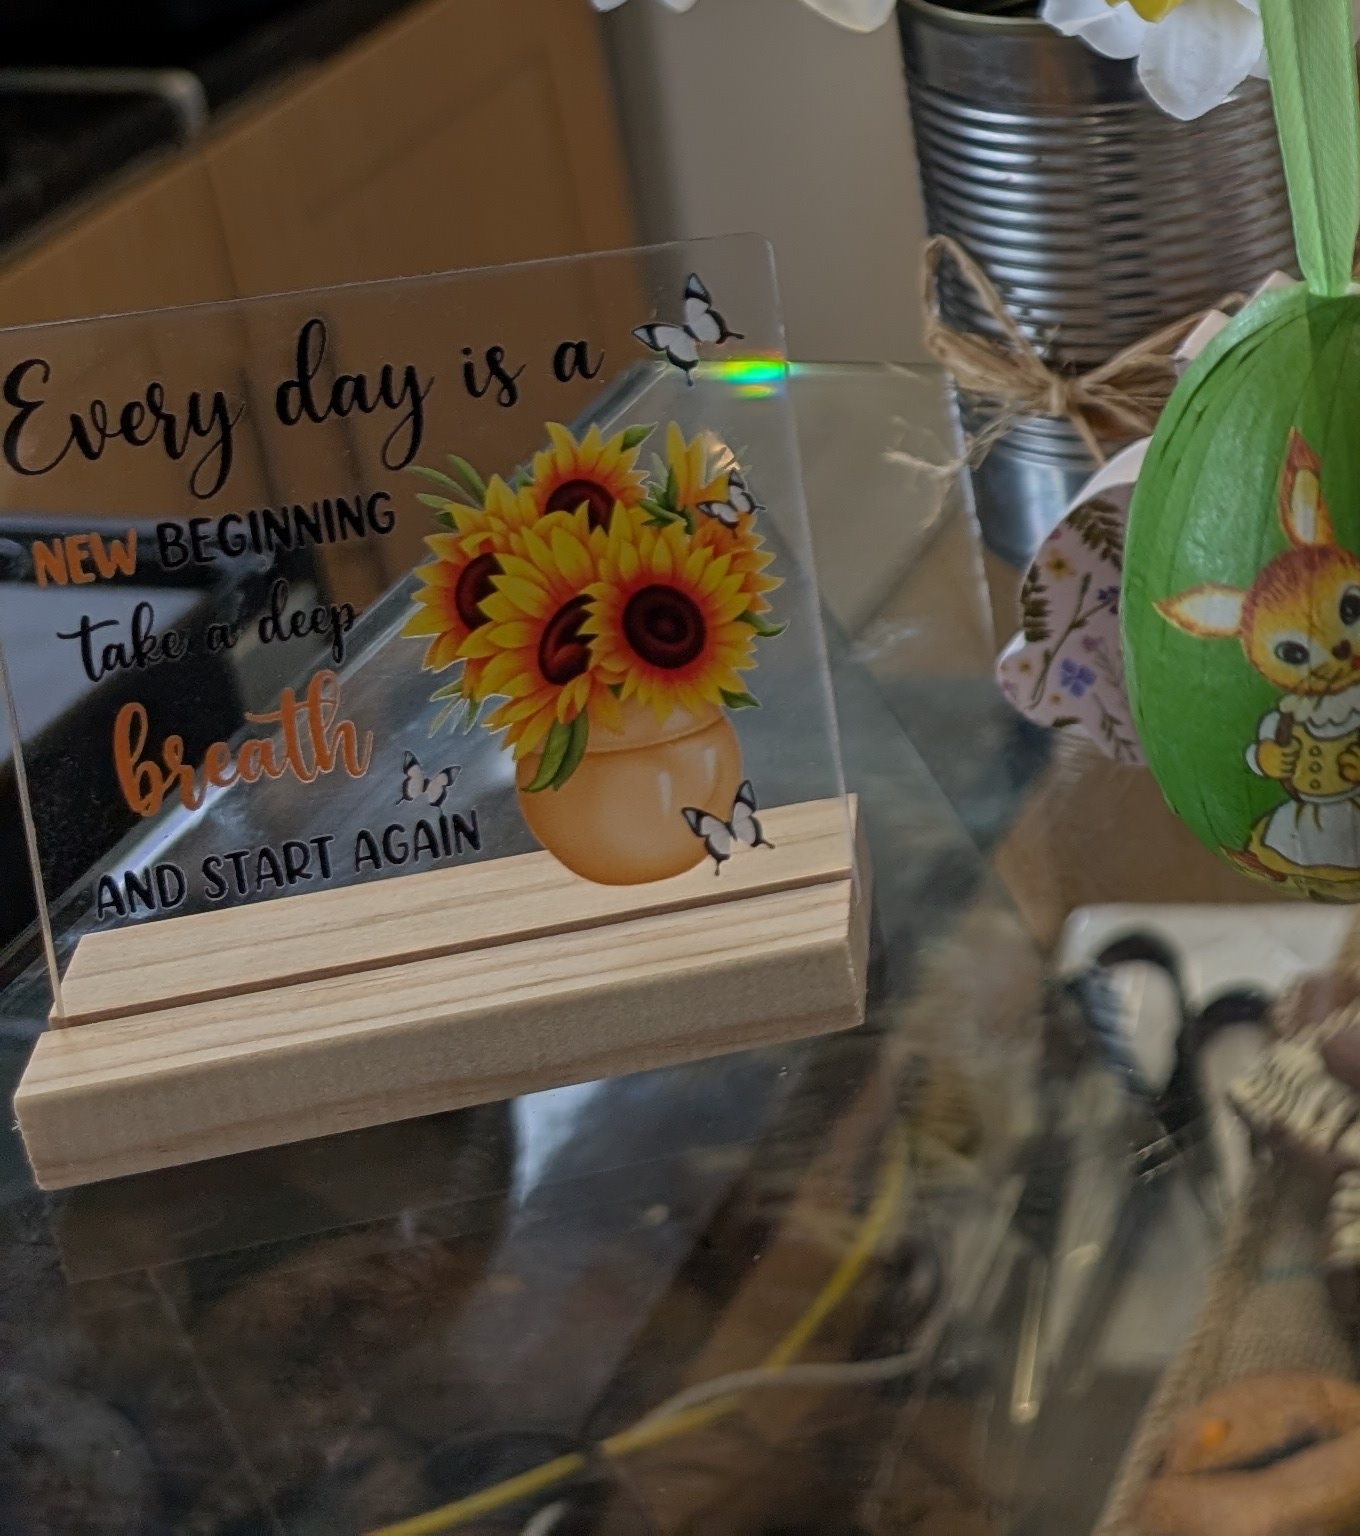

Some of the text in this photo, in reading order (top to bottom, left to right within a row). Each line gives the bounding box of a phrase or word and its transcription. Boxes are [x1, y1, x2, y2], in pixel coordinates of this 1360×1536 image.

[2, 318, 606, 500] Every day is a
[31, 491, 397, 588] NEW BEGINNING
[56, 577, 360, 683] take a deep
[112, 669, 374, 818] breath
[97, 809, 482, 920] AND START AGAIN
